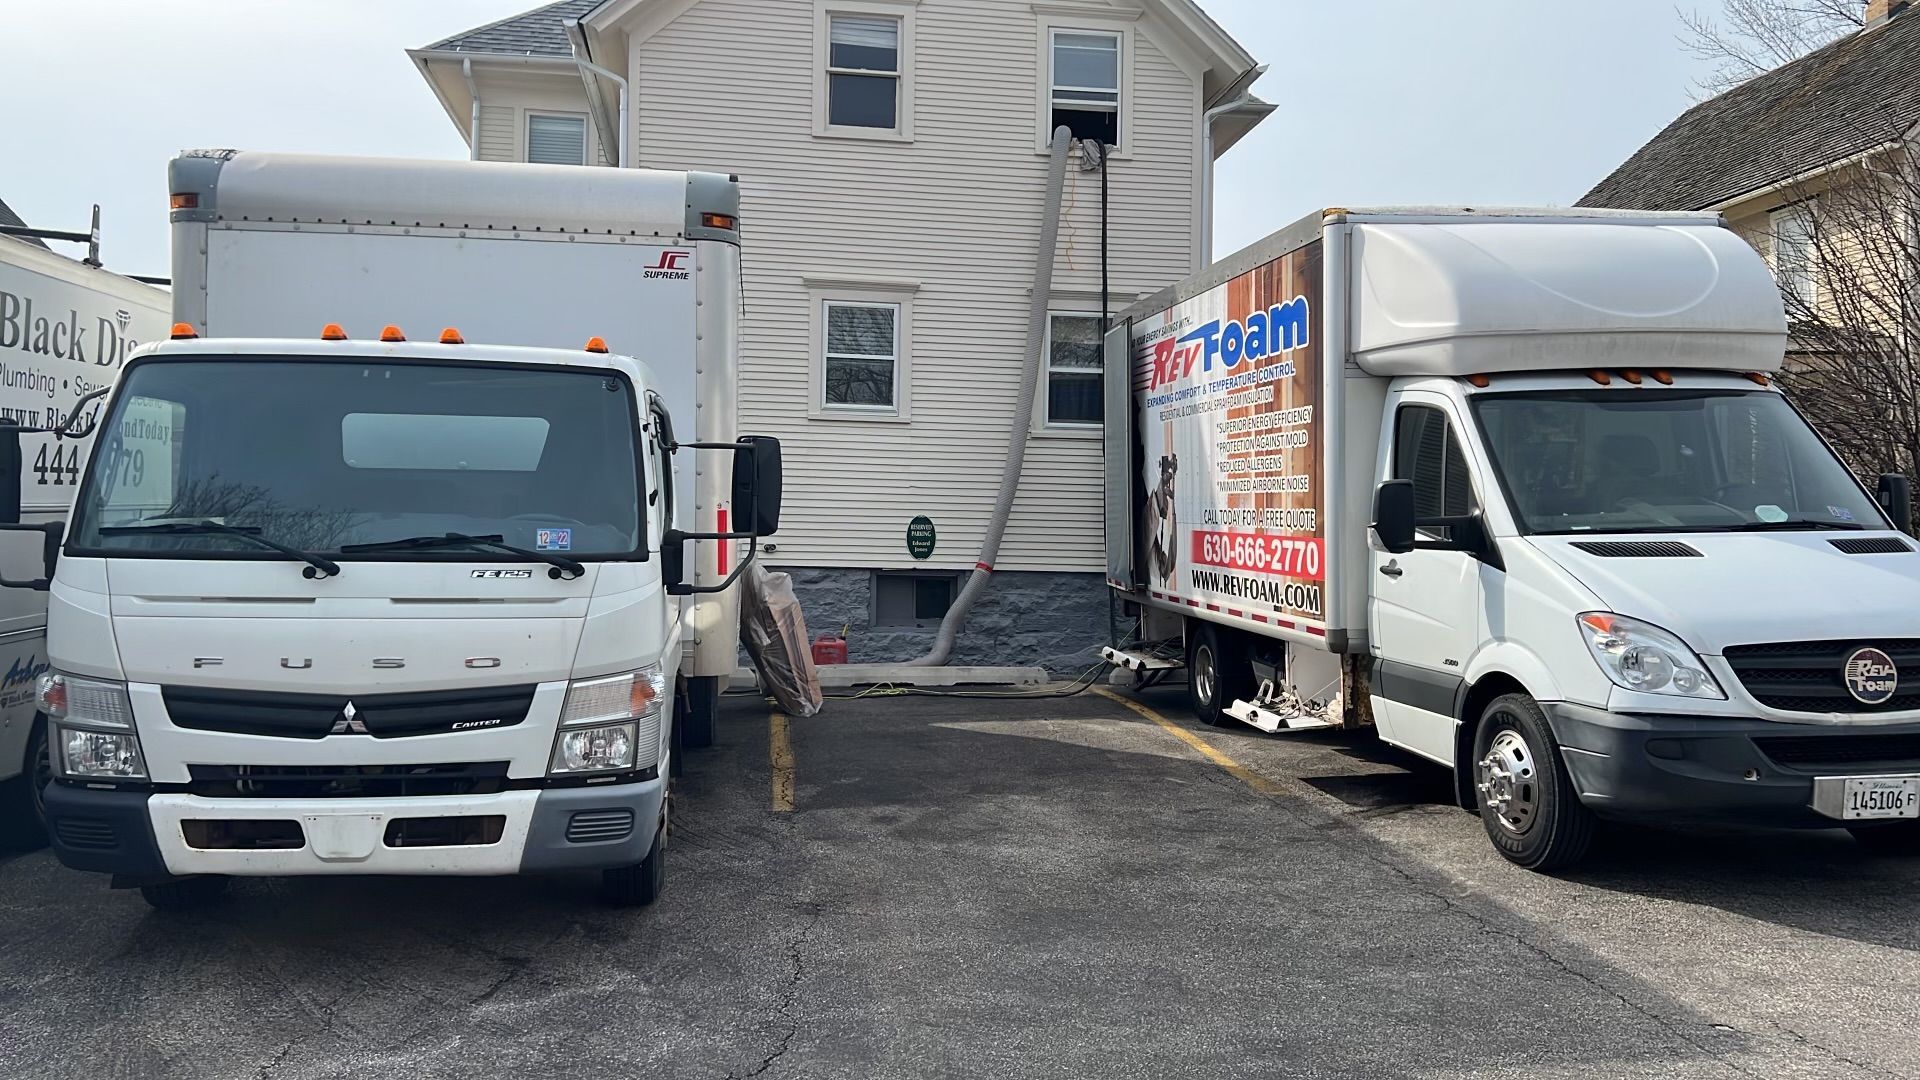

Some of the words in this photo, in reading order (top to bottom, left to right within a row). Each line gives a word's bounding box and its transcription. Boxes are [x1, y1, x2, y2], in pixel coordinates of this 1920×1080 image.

[643, 271, 690, 280] SUPREME
[0, 291, 87, 362] Black
[0, 363, 57, 399] lumbing
[1147, 393, 1174, 409] EXPANDING
[1175, 386, 1200, 402] COMFORT
[1202, 383, 1207, 395] &
[1209, 370, 1257, 393] TEMPERATURE
[1258, 361, 1296, 382] CONTROL
[1160, 408, 1182, 422] RESIDENTIAL
[1186, 399, 1213, 416] COMMERCIAL
[1214, 396, 1227, 411] SPRAY
[1228, 393, 1241, 409] FOAM
[1242, 387, 1273, 407] INSULATION
[1248, 412, 1273, 430] ENERGY
[1274, 407, 1312, 426] EFFICIENCY
[1256, 434, 1284, 450] AGAINST
[1286, 431, 1308, 447] MOLD
[1247, 456, 1282, 471] ALLERGENS
[1253, 478, 1286, 492] AIRBORNE
[1287, 477, 1309, 491] NOISE
[1204, 509, 1218, 524] CALL
[1220, 509, 1240, 525] TODAY
[1243, 510, 1256, 526] FOR
[1258, 511, 1264, 526] A
[1266, 510, 1284, 528] FREE
[1286, 511, 1316, 530] QUOTE
[539, 531, 549, 545] 12
[1203, 533, 1319, 576] 630-666-2770
[1191, 569, 1319, 613] WWW.REVFOAM.COM
[194, 656, 501, 669] FUSO
[1851, 790, 1903, 810] 145106
[1907, 793, 1917, 806] F
